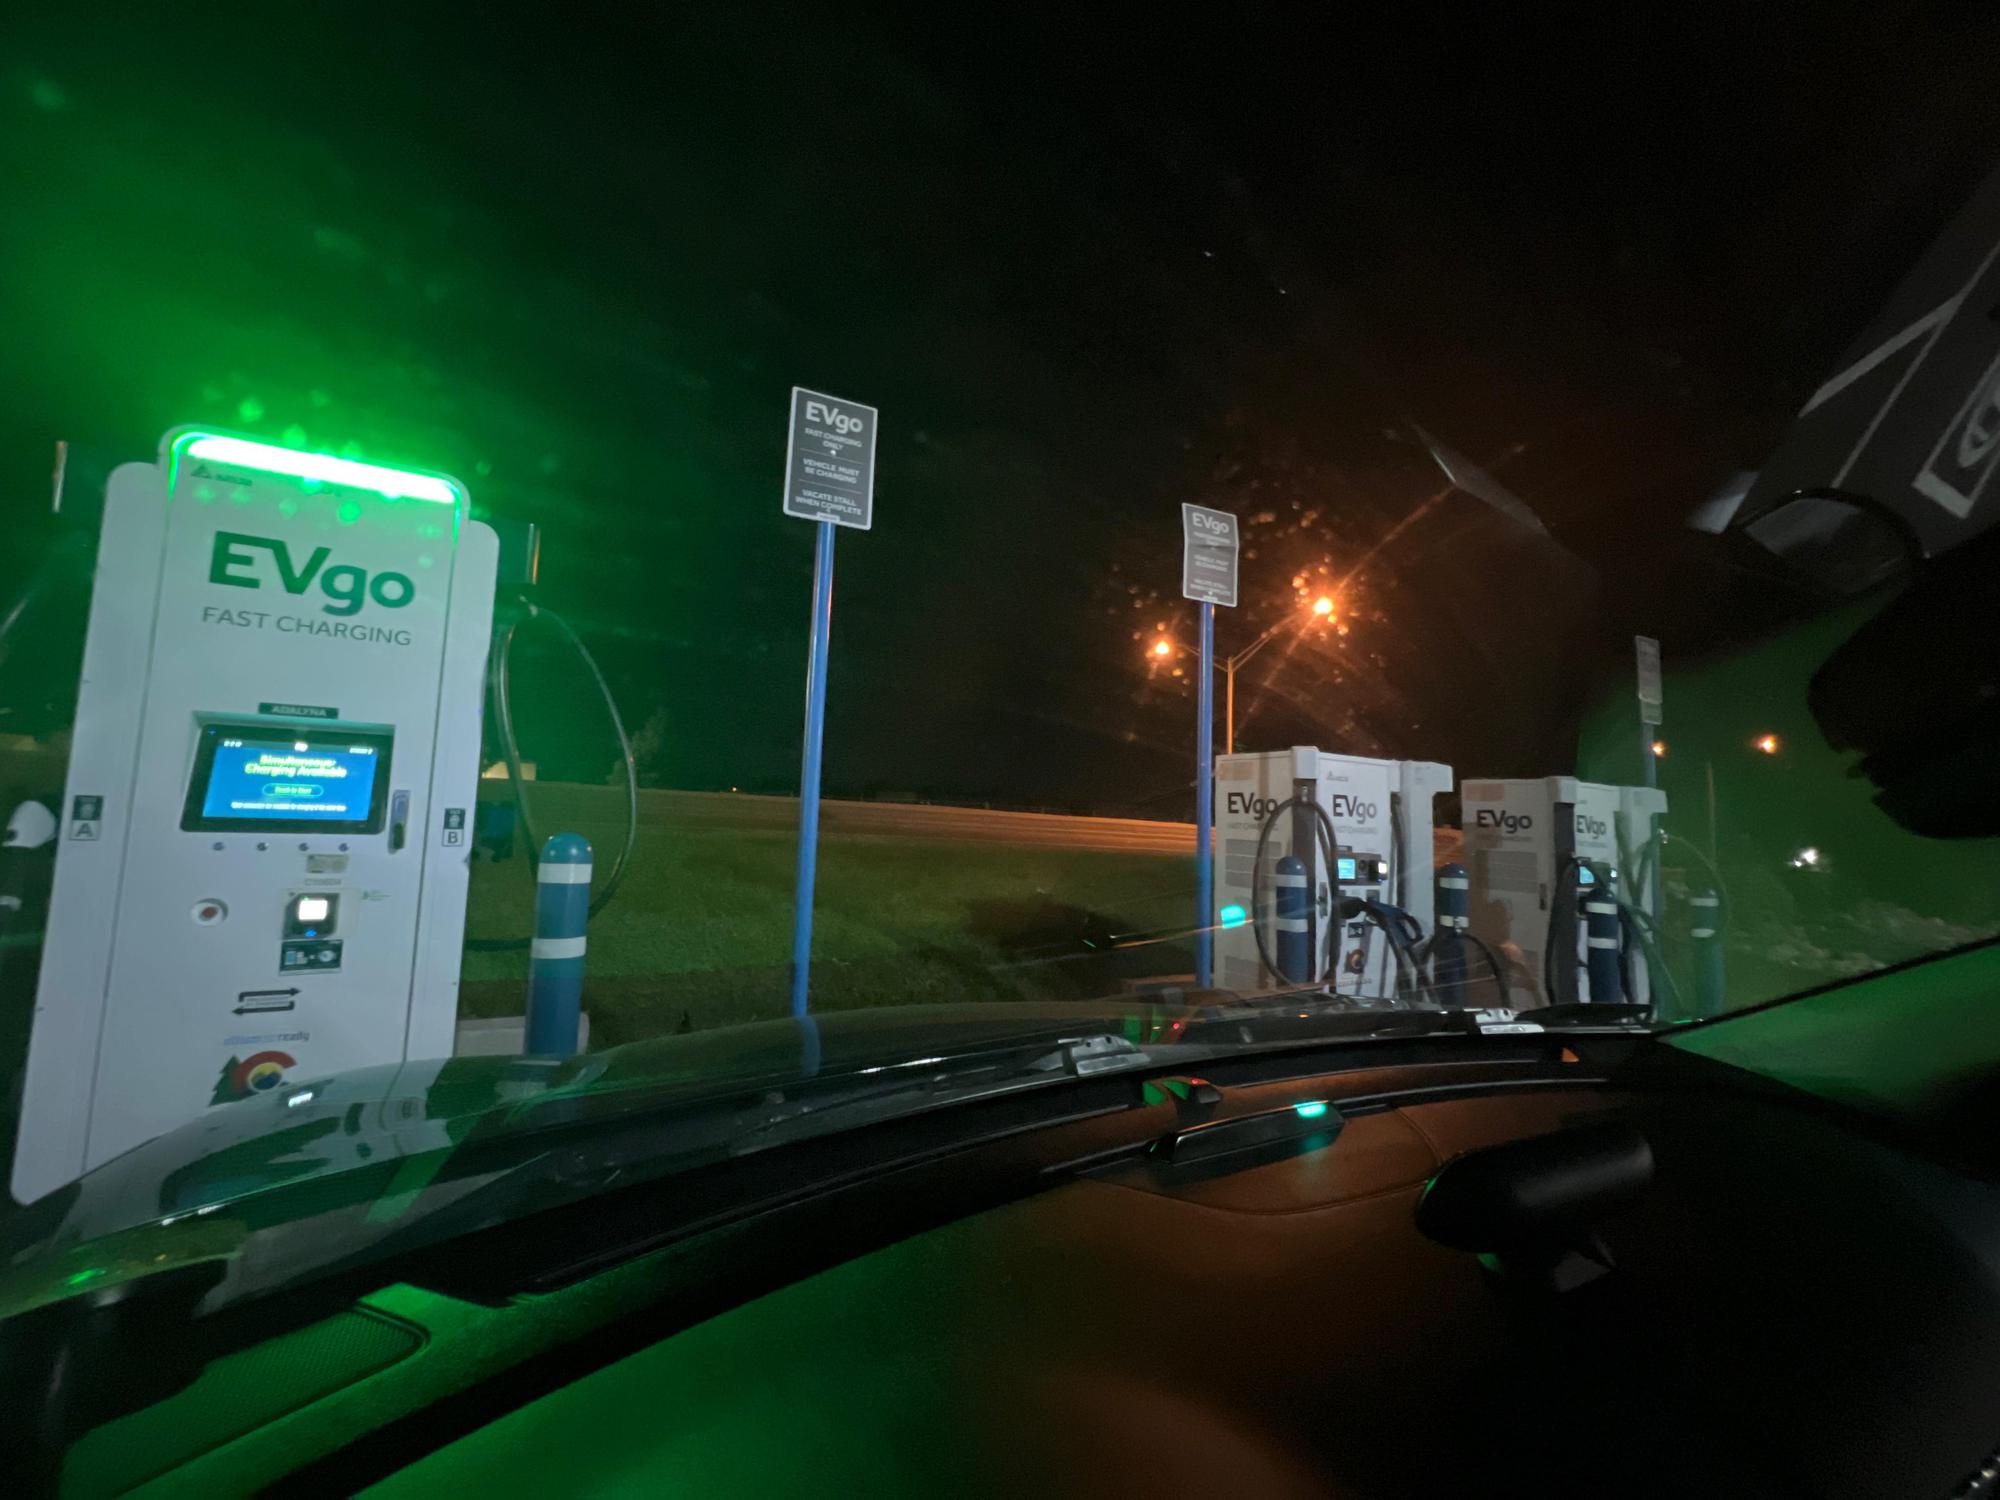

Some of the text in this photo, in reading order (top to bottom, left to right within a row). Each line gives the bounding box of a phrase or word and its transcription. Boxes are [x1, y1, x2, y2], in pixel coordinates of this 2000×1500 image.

[806, 400, 863, 434] EVgo
[805, 427, 862, 448] FAST CHARGING
[822, 440, 844, 450] ONLY
[803, 458, 860, 477] VEHICLE MUST
[804, 466, 857, 484] BE CHARGING
[795, 495, 861, 515] WHEN COMPLETE
[802, 489, 856, 507] VACATE STALL
[1192, 512, 1230, 534] EVgo
[209, 530, 415, 617] EVgo
[202, 606, 412, 646] FAST CHARGING
[245, 762, 296, 778] Charging
[1227, 792, 1278, 821] EVgo
[1332, 794, 1377, 824] EVgo
[75, 822, 94, 838] A
[1476, 809, 1533, 834] EVgo
[1576, 814, 1607, 839] EVgo
[447, 831, 459, 844] B
